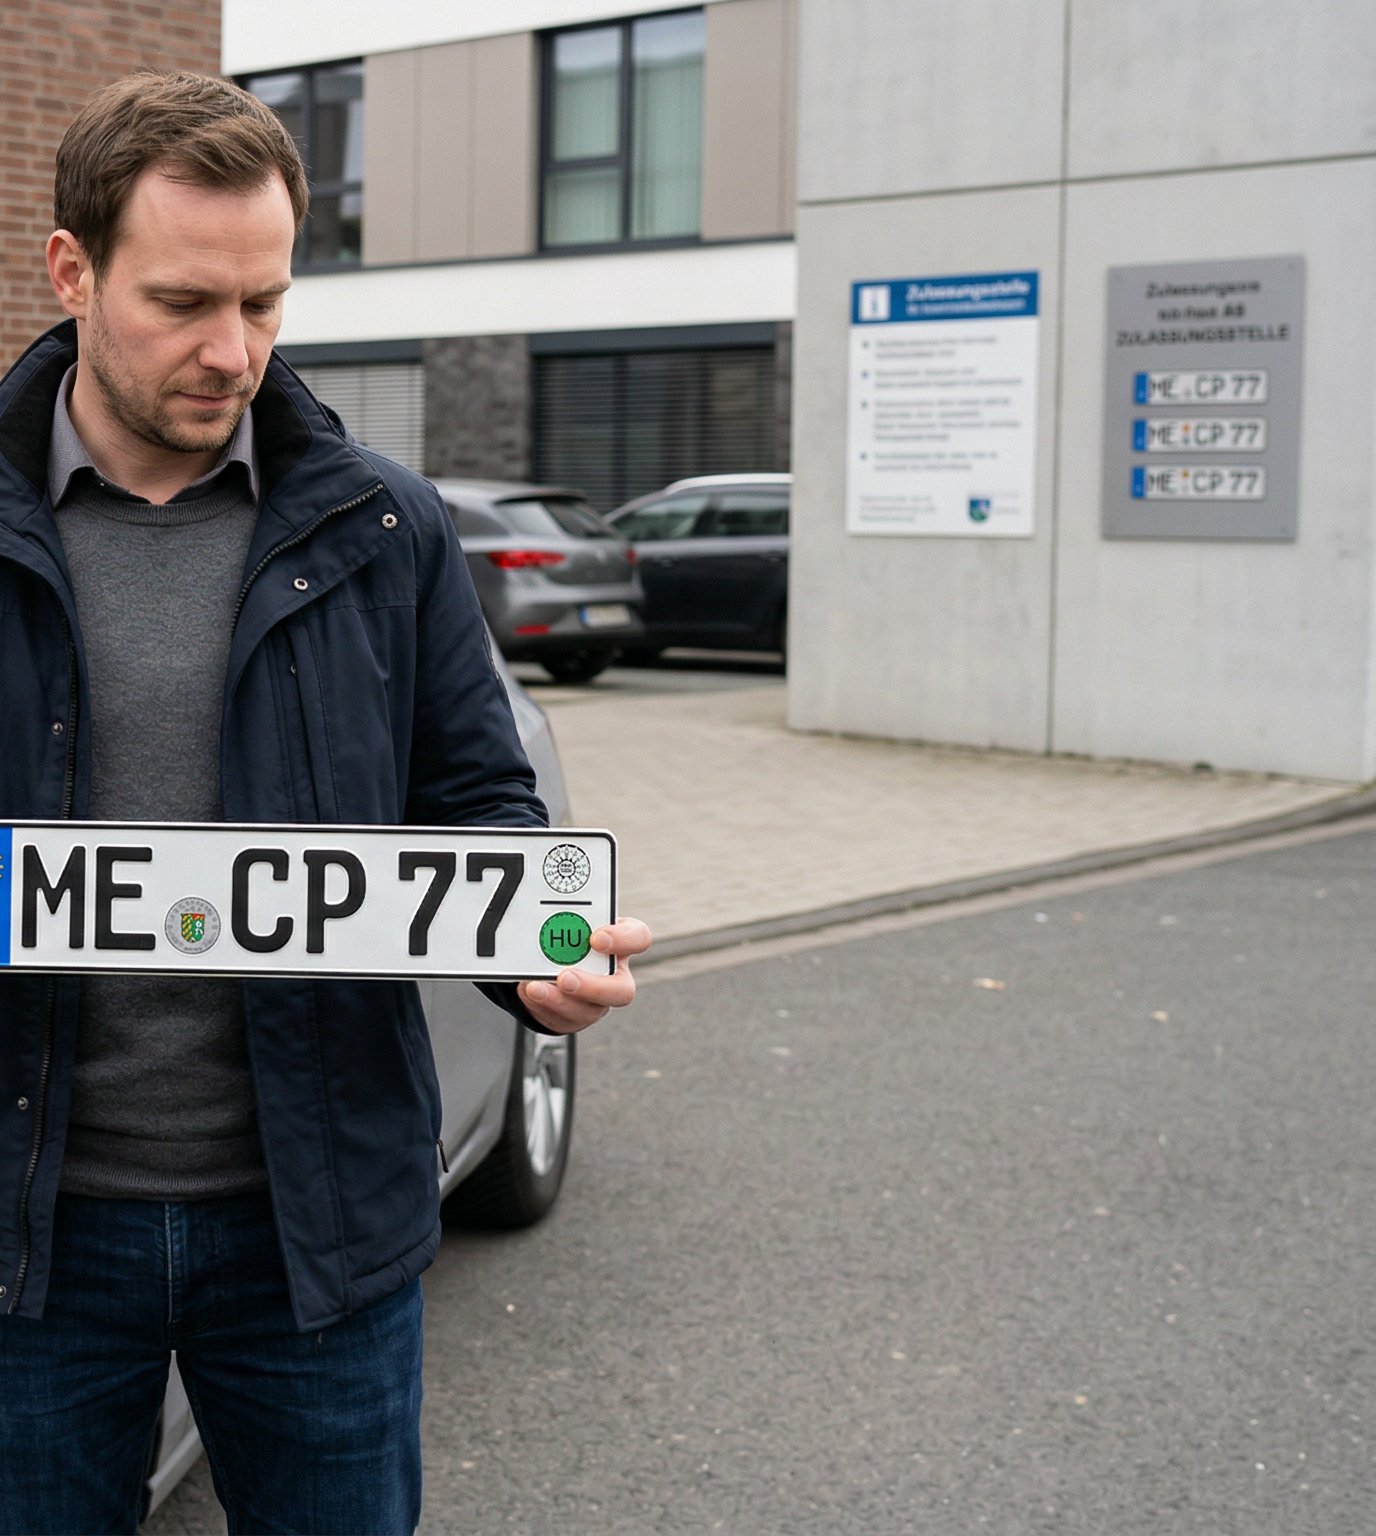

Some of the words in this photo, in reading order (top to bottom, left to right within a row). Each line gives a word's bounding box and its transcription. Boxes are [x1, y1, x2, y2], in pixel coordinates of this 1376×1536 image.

[1195, 373, 1225, 398] CP
[1231, 374, 1261, 397] 77
[1194, 422, 1224, 445] CP
[1230, 422, 1259, 444] 77
[1192, 470, 1223, 493] CP
[1229, 470, 1259, 493] 77
[21, 845, 156, 951] ME
[231, 847, 367, 954] CP
[398, 850, 525, 957] 77
[549, 928, 582, 948] HU
